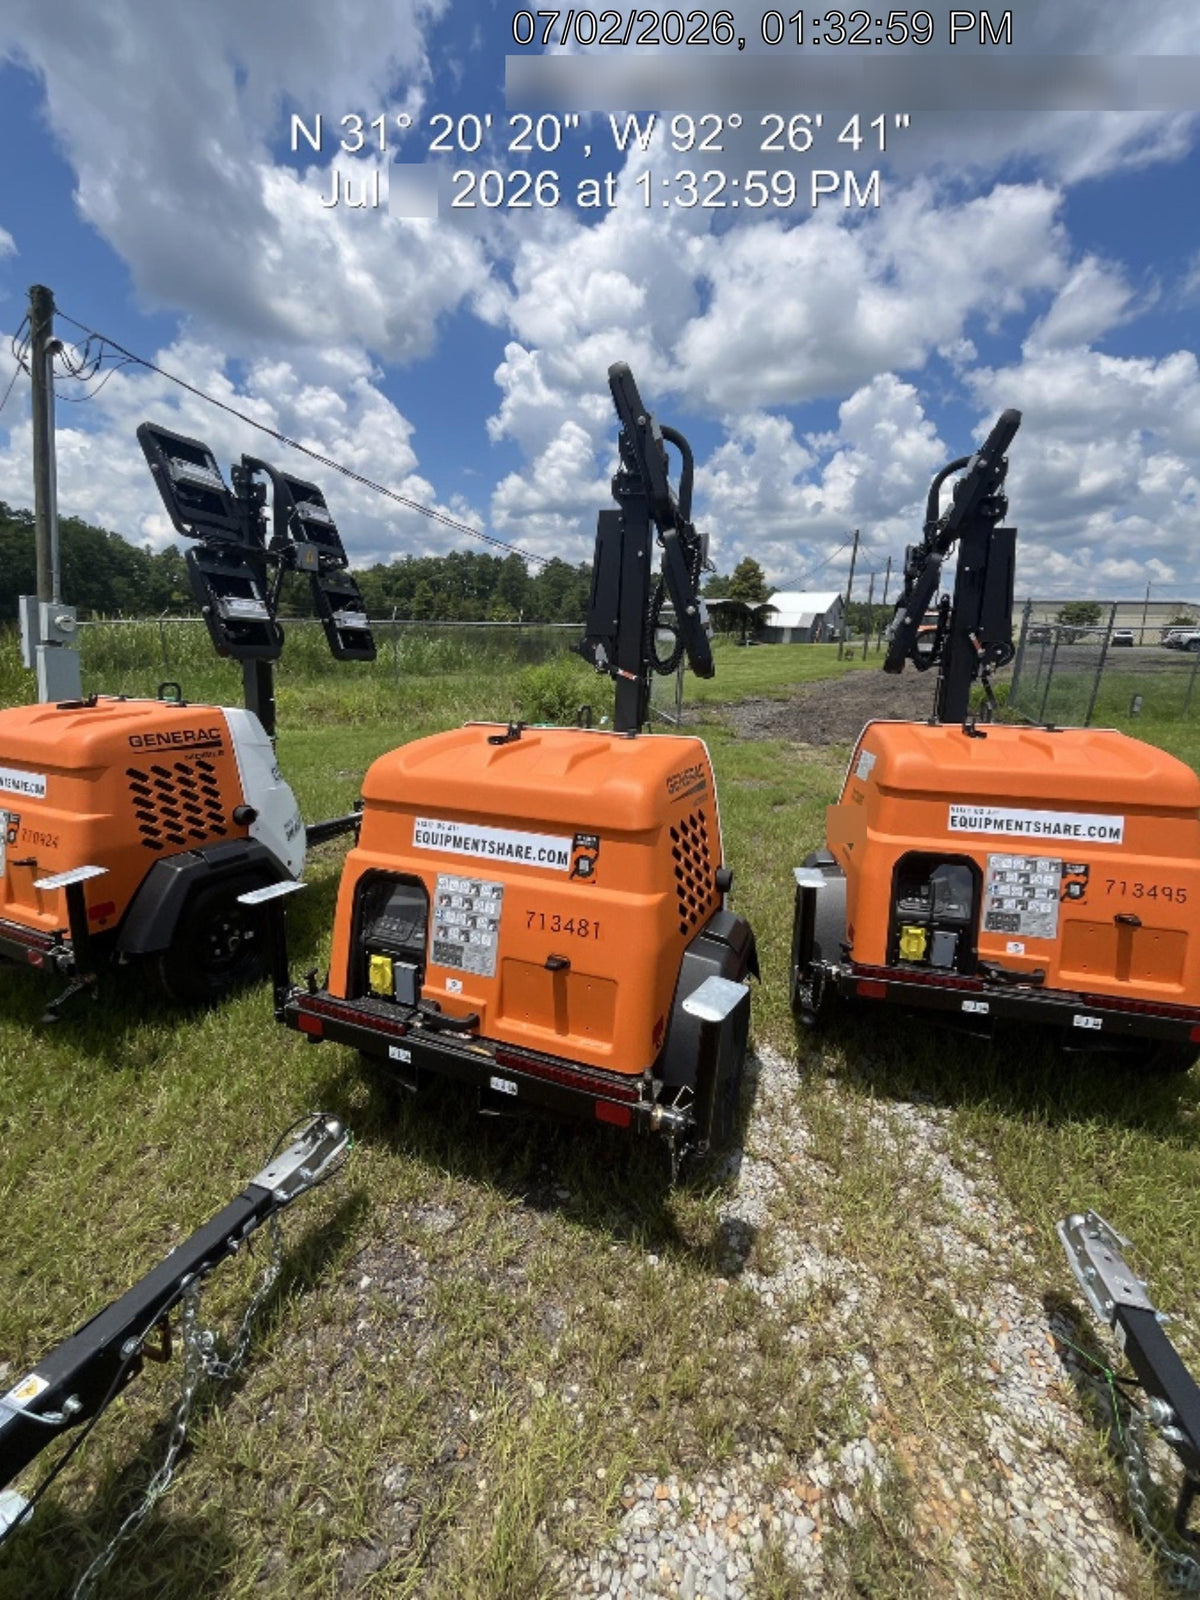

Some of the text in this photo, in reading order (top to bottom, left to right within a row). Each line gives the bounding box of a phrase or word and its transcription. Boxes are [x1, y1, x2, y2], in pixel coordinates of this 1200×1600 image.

[128, 727, 222, 748] GENERAC
[950, 815, 1122, 841] EQUIPMENTSHARE.COM
[415, 829, 569, 867] EQUIPMENTSHARE.COM
[1105, 879, 1188, 904] 713495
[526, 910, 600, 939] 713481
